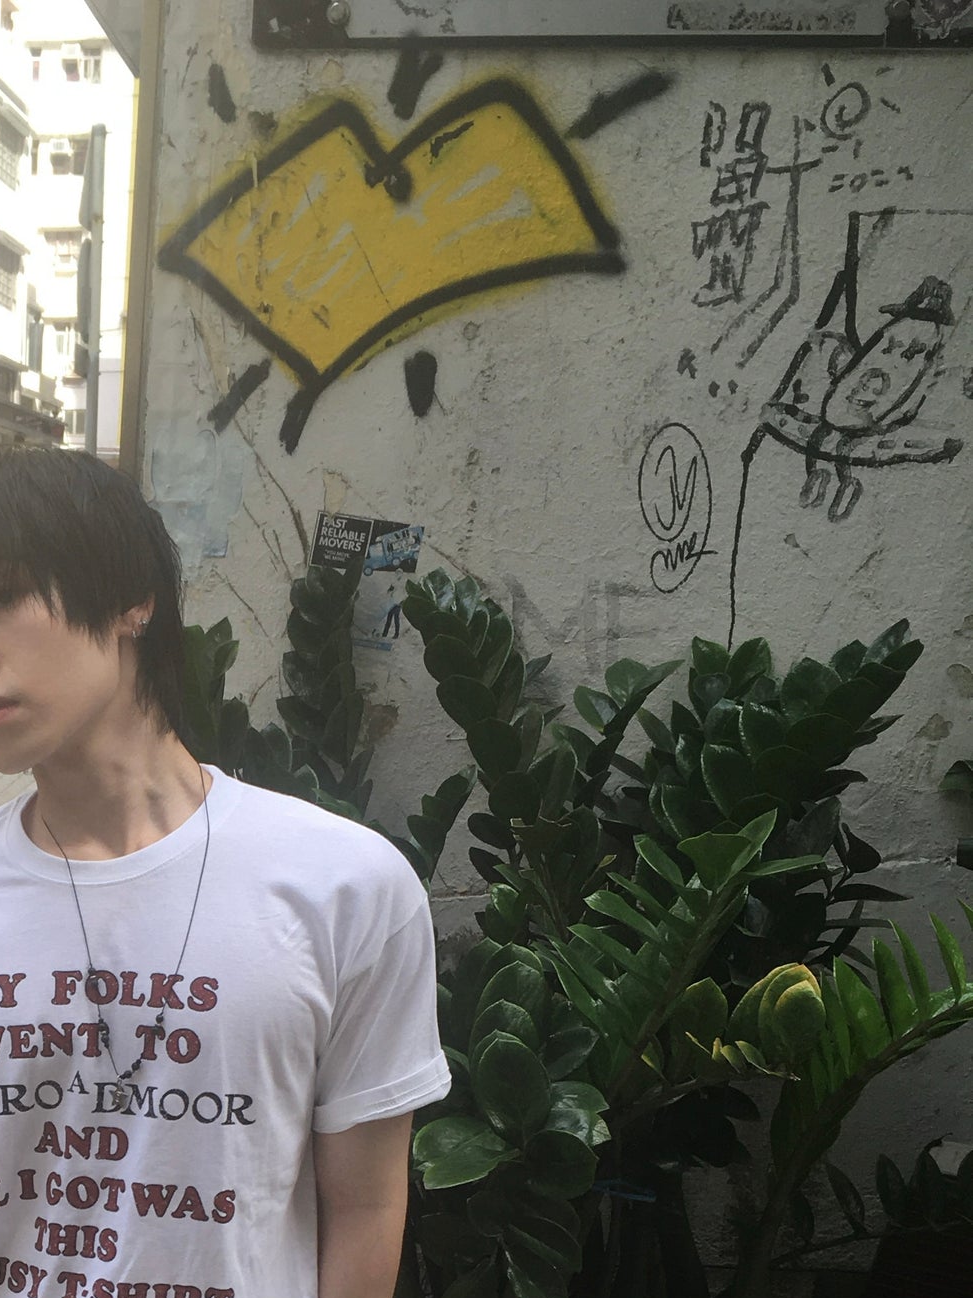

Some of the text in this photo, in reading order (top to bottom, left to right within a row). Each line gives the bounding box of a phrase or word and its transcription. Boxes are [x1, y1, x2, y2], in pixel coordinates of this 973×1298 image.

[321, 526, 367, 543] RELIABLE
[322, 516, 348, 529] FAST
[318, 536, 362, 552] MOVERS
[51, 969, 220, 1013] FOLKS
[135, 1024, 202, 1064] TO
[34, 1120, 130, 1161] AND
[17, 1168, 38, 1201] I
[45, 1170, 127, 1213] GOT
[131, 1181, 237, 1224] WAS
[34, 1216, 119, 1262] THIS
